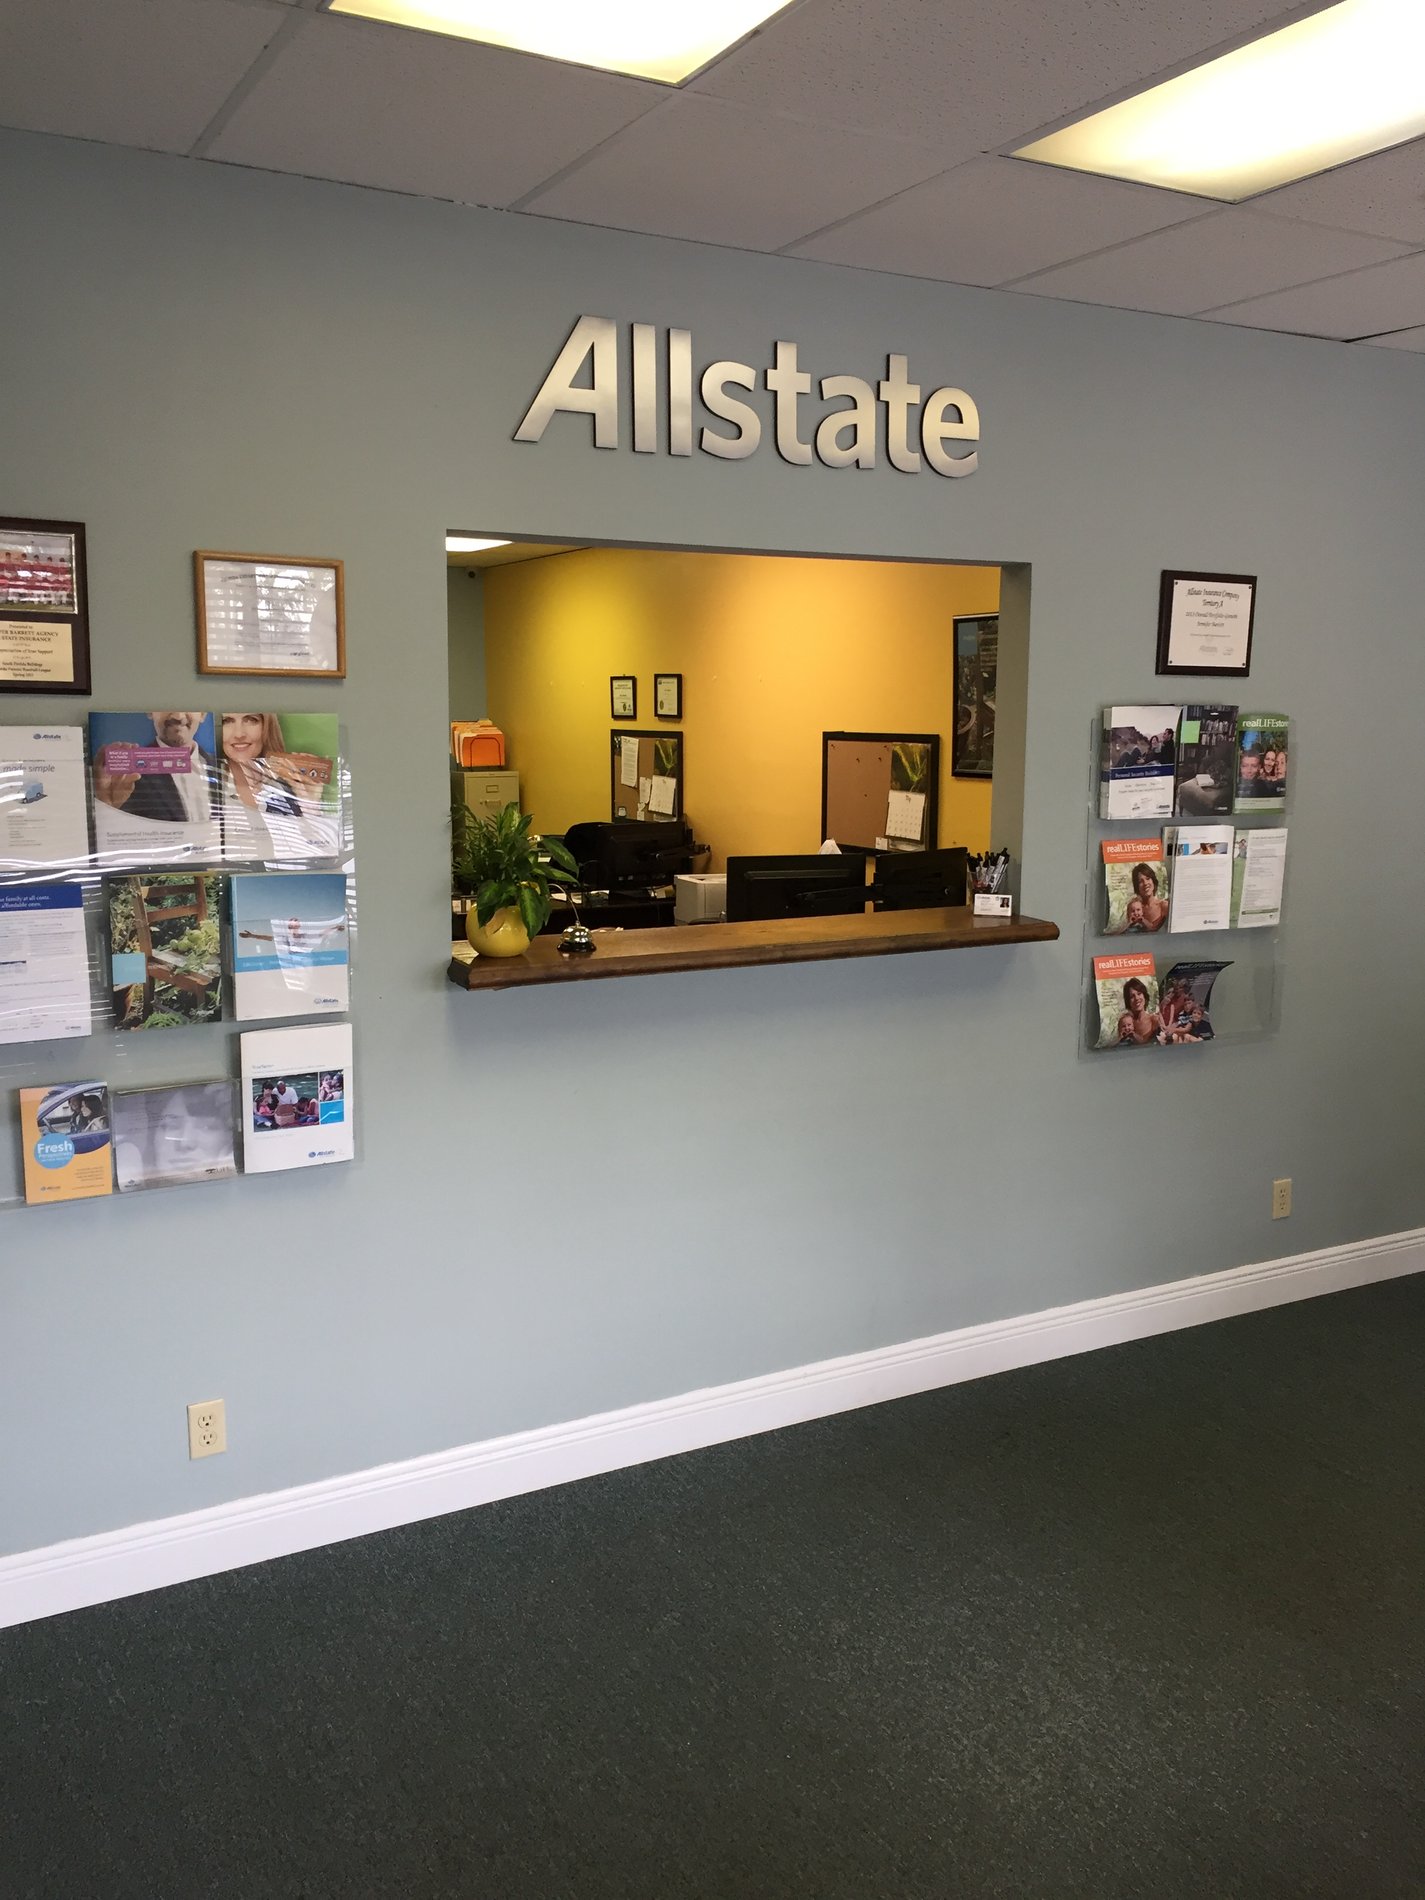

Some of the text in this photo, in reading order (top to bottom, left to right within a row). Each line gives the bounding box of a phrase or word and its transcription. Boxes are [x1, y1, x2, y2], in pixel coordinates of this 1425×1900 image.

[513, 315, 980, 479] Allstate
[1203, 589, 1222, 597] Insurance
[1222, 590, 1240, 601] Company
[2, 764, 56, 774] made simple
[1106, 842, 1160, 853] realLIFEstories
[1098, 957, 1152, 970] realLIFEstories
[36, 1140, 73, 1154] Fresh
